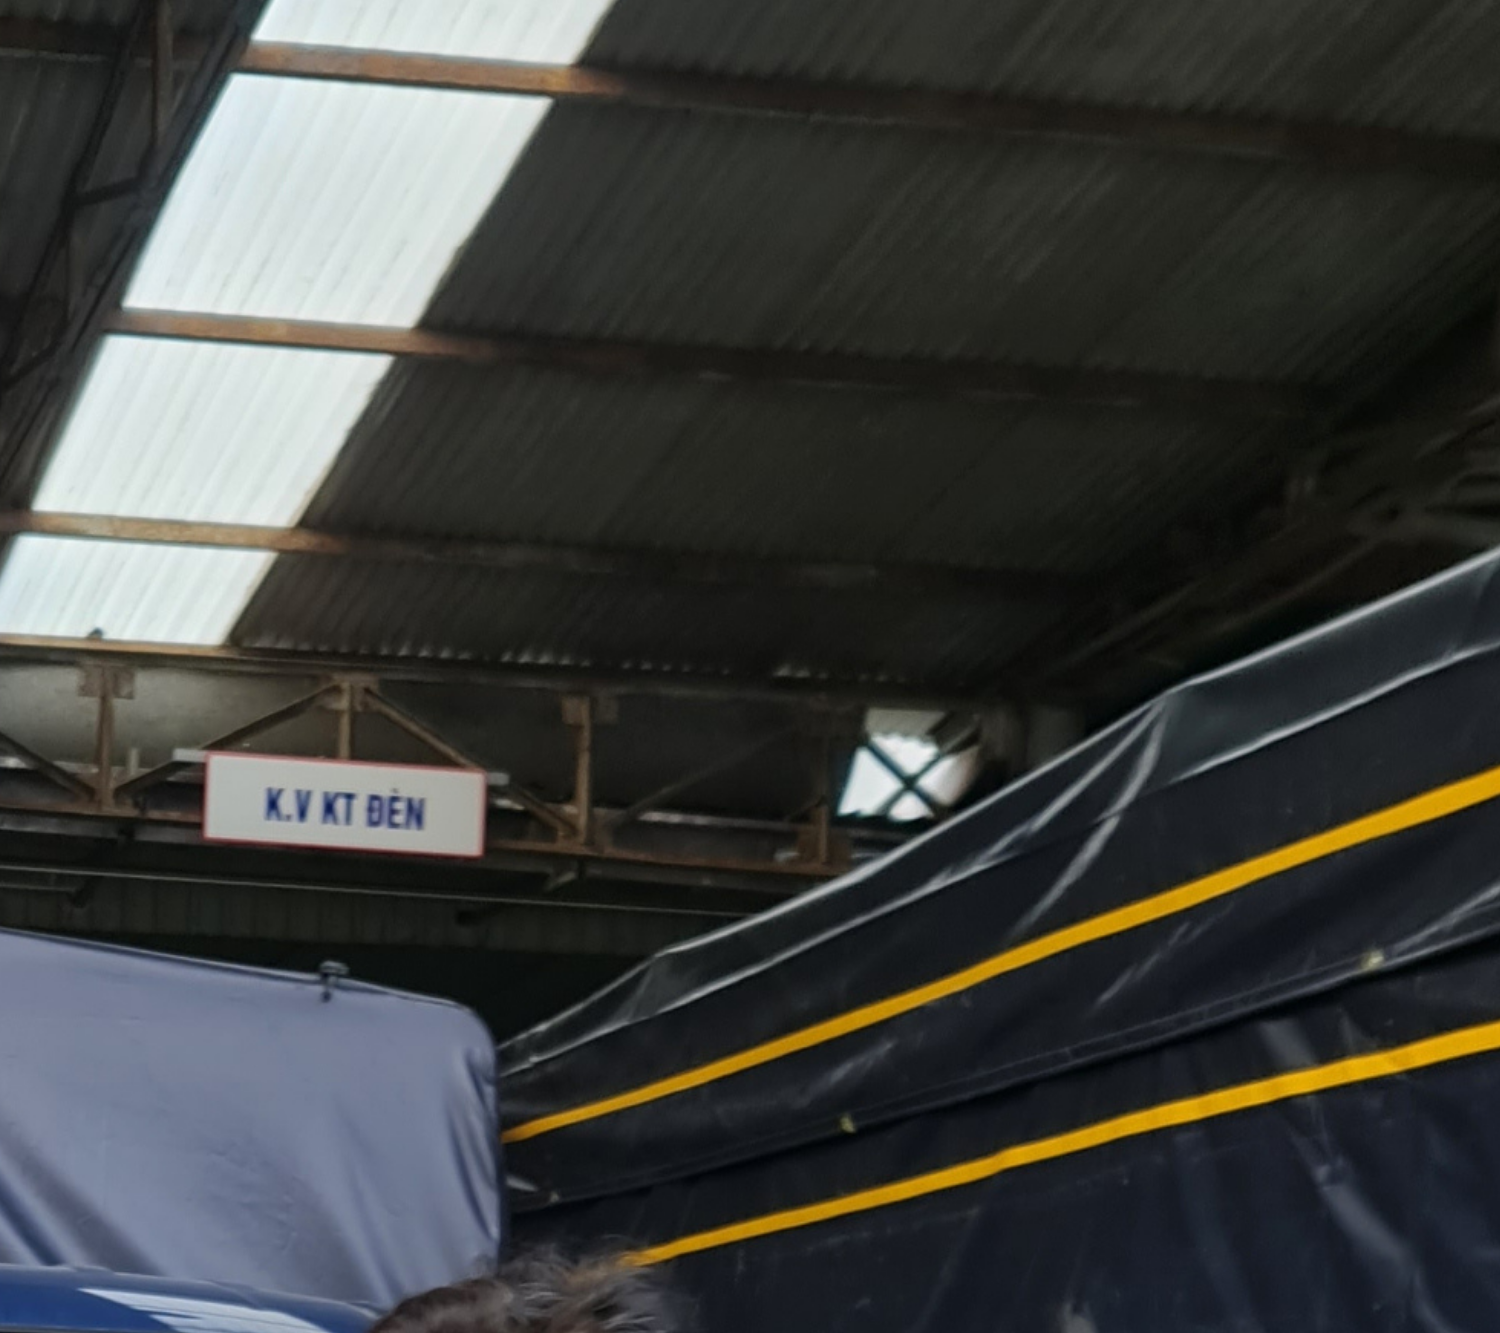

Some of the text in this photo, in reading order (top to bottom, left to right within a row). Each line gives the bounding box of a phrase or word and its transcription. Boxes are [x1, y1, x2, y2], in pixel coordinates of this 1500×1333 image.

[264, 787, 426, 831] K.V KT ĐÈN
